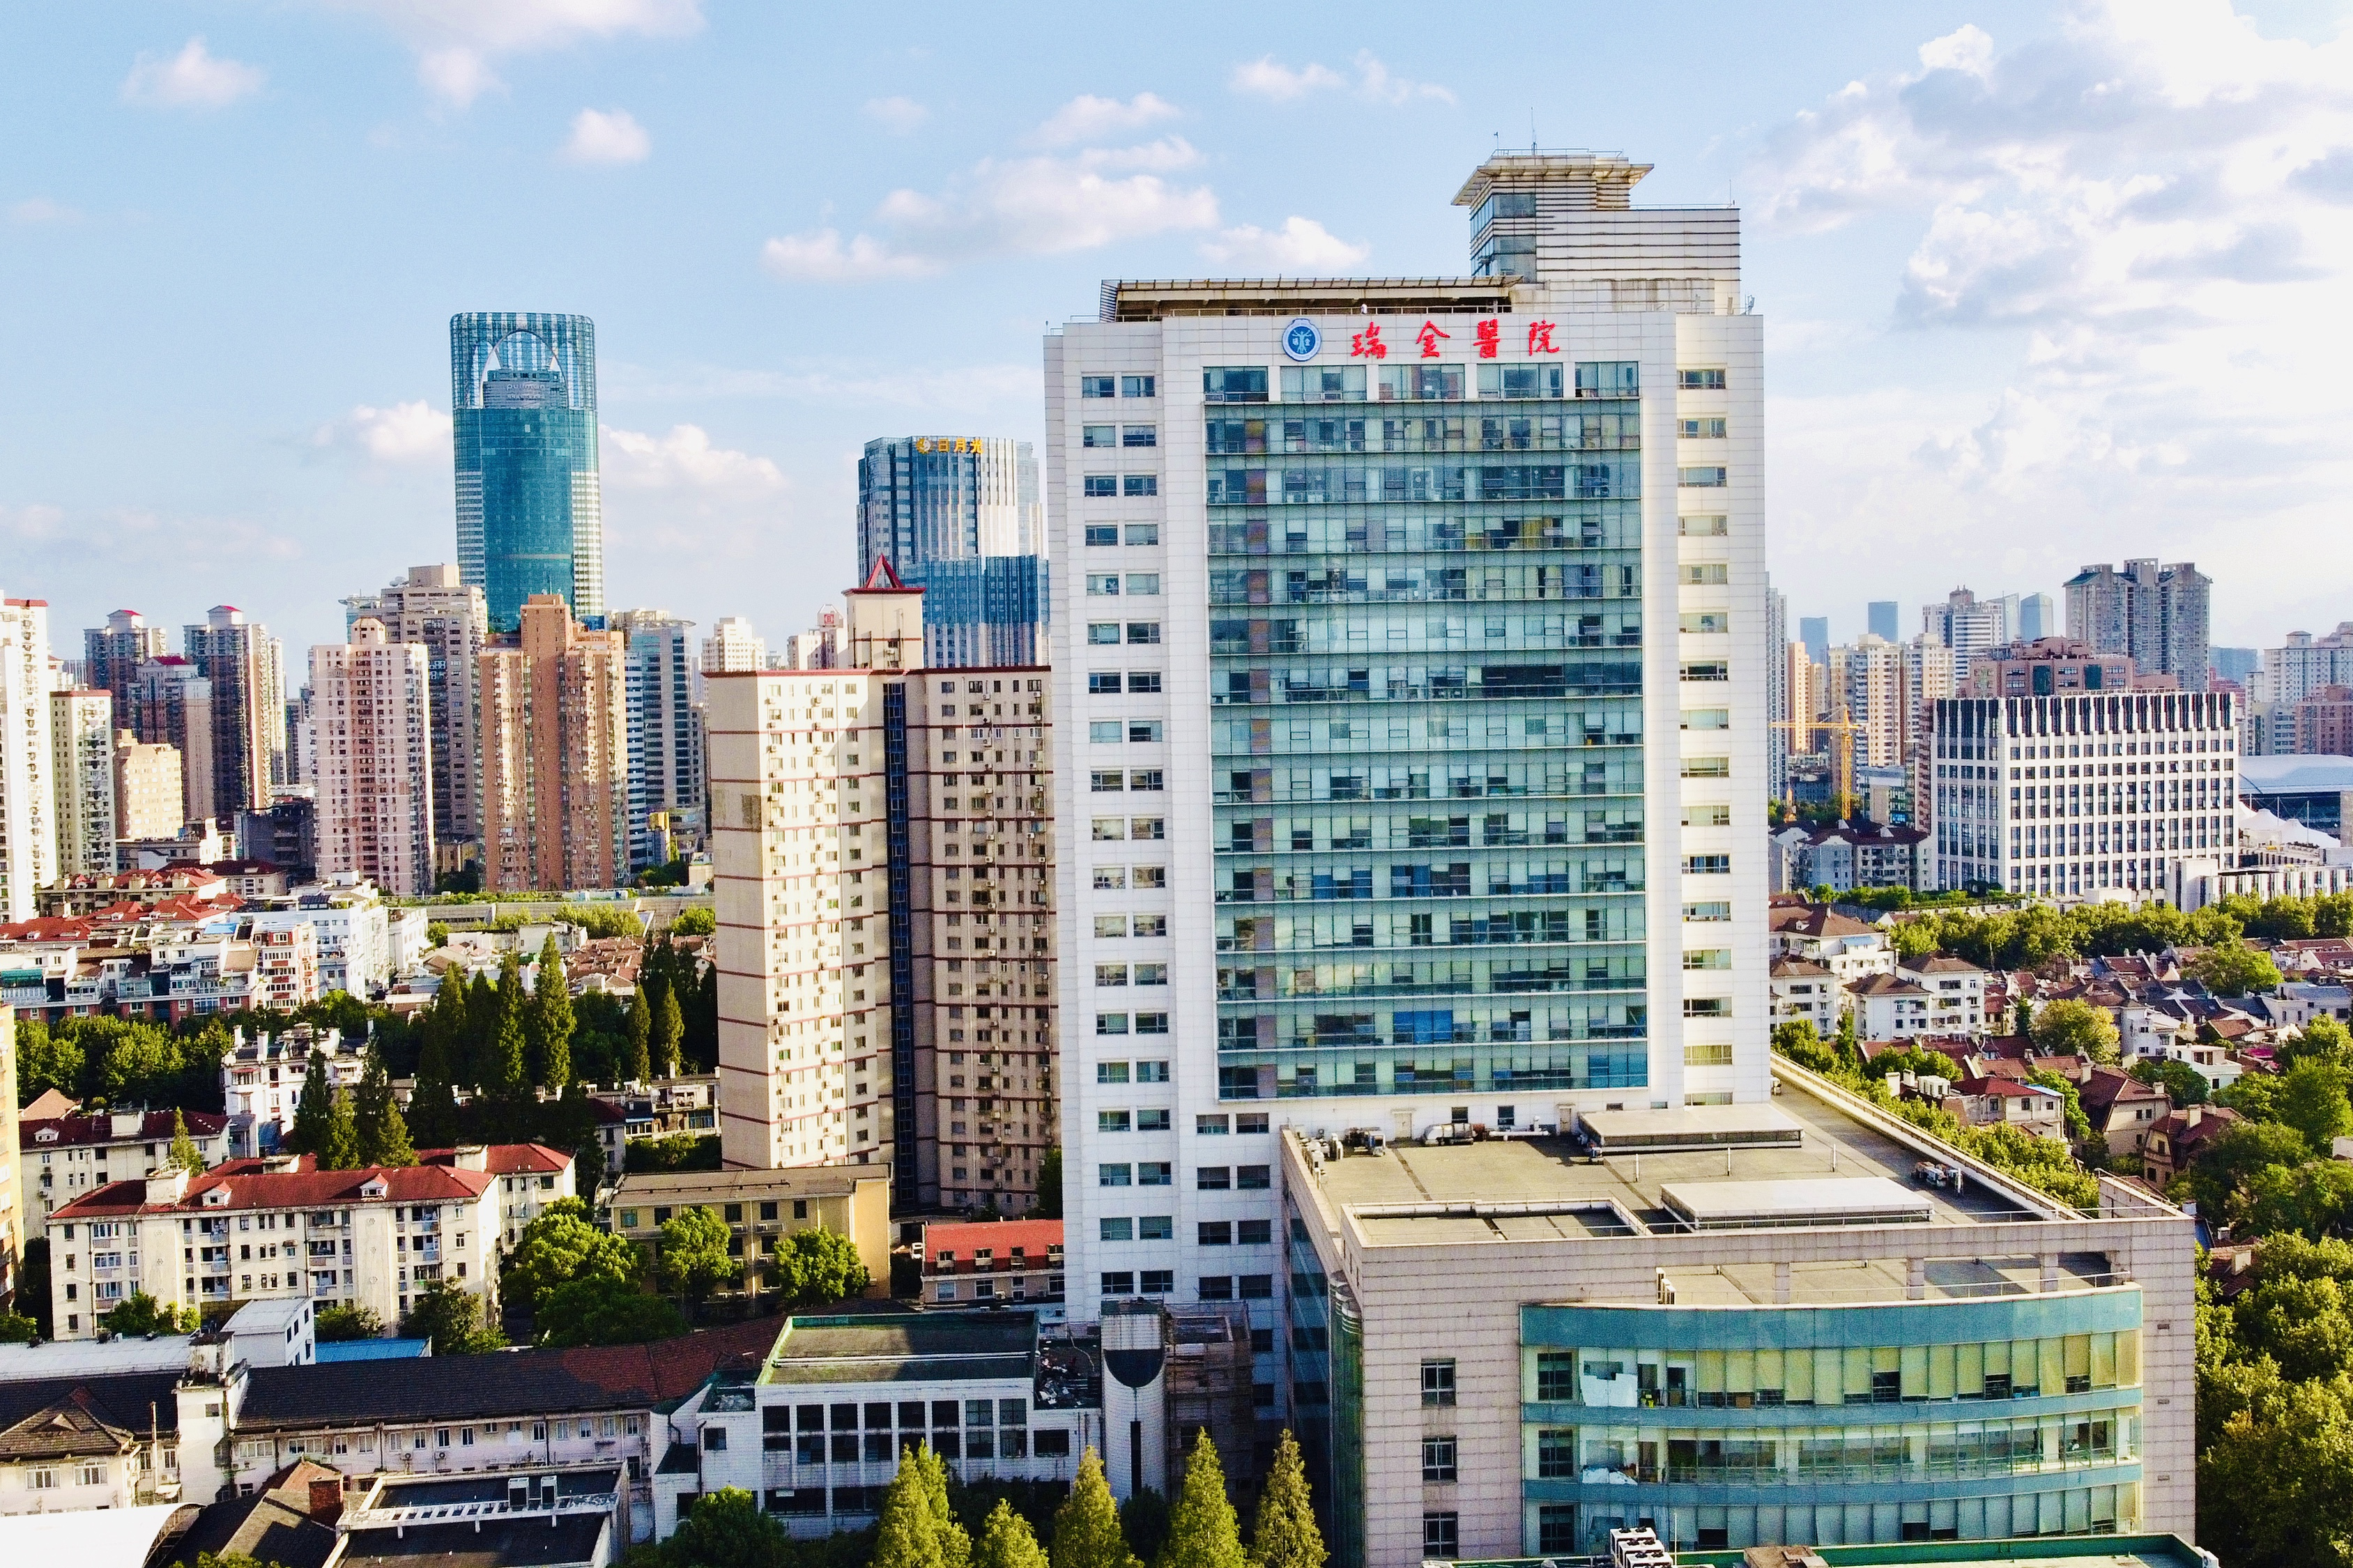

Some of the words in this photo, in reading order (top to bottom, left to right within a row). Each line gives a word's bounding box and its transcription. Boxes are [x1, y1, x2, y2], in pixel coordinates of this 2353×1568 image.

[1351, 318, 1559, 358] 瑞金醫院
[937, 438, 983, 454] 日月光
